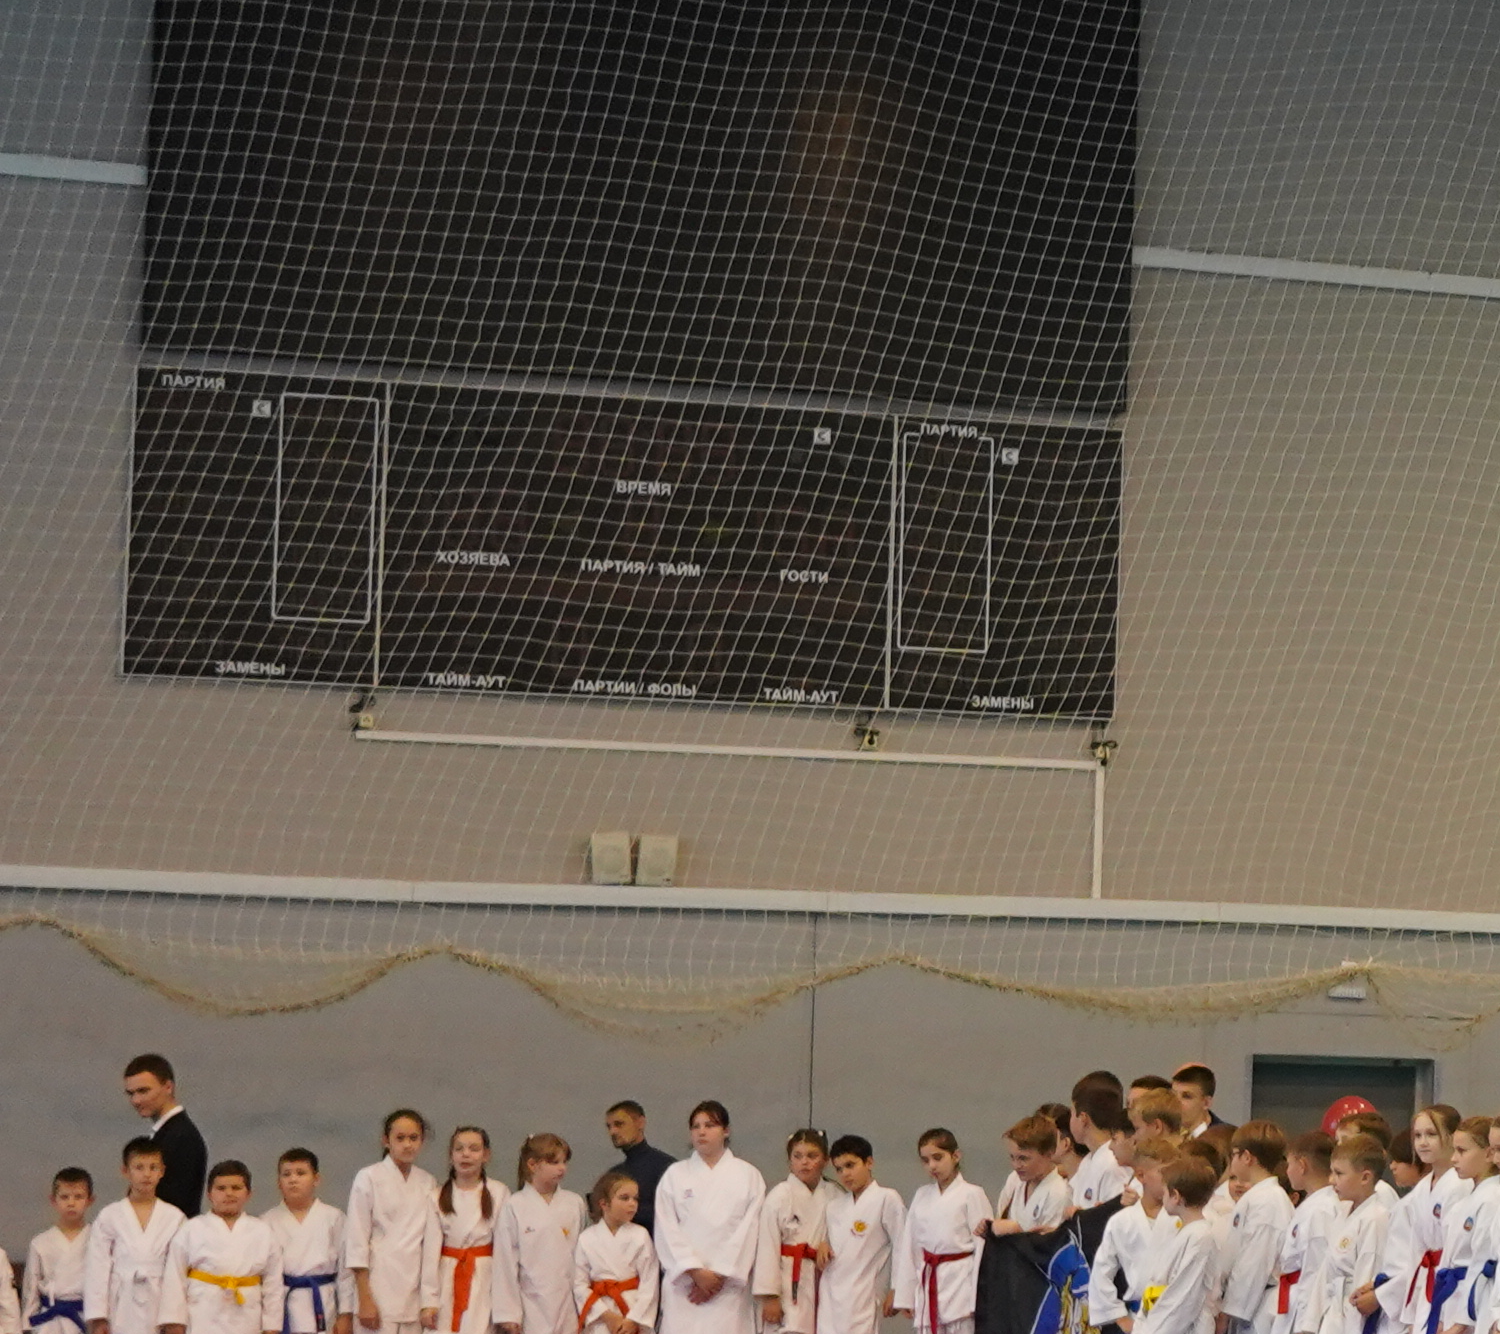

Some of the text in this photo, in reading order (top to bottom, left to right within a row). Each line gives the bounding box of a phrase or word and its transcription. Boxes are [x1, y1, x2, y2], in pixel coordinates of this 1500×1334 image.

[161, 374, 226, 390] ПАРТИЯ
[920, 423, 978, 439] ПАРТИЯ
[616, 480, 672, 496] ВРЕМЯ
[437, 551, 511, 566] ХОЗЯЕВА
[580, 559, 645, 575] ПАРТИЯ
[653, 562, 700, 577] ТАЙМ
[780, 569, 829, 584] ГОСТИ
[214, 660, 286, 676] ЗАМЕНЫ
[427, 672, 507, 688] ТАЙМ-АУТ
[573, 679, 637, 695] ПАРТИИ
[647, 682, 697, 697] ФОЛЫ
[763, 687, 839, 703] ТАЙМ-АУТ
[971, 694, 1034, 710] ЗАМЕНЫ
